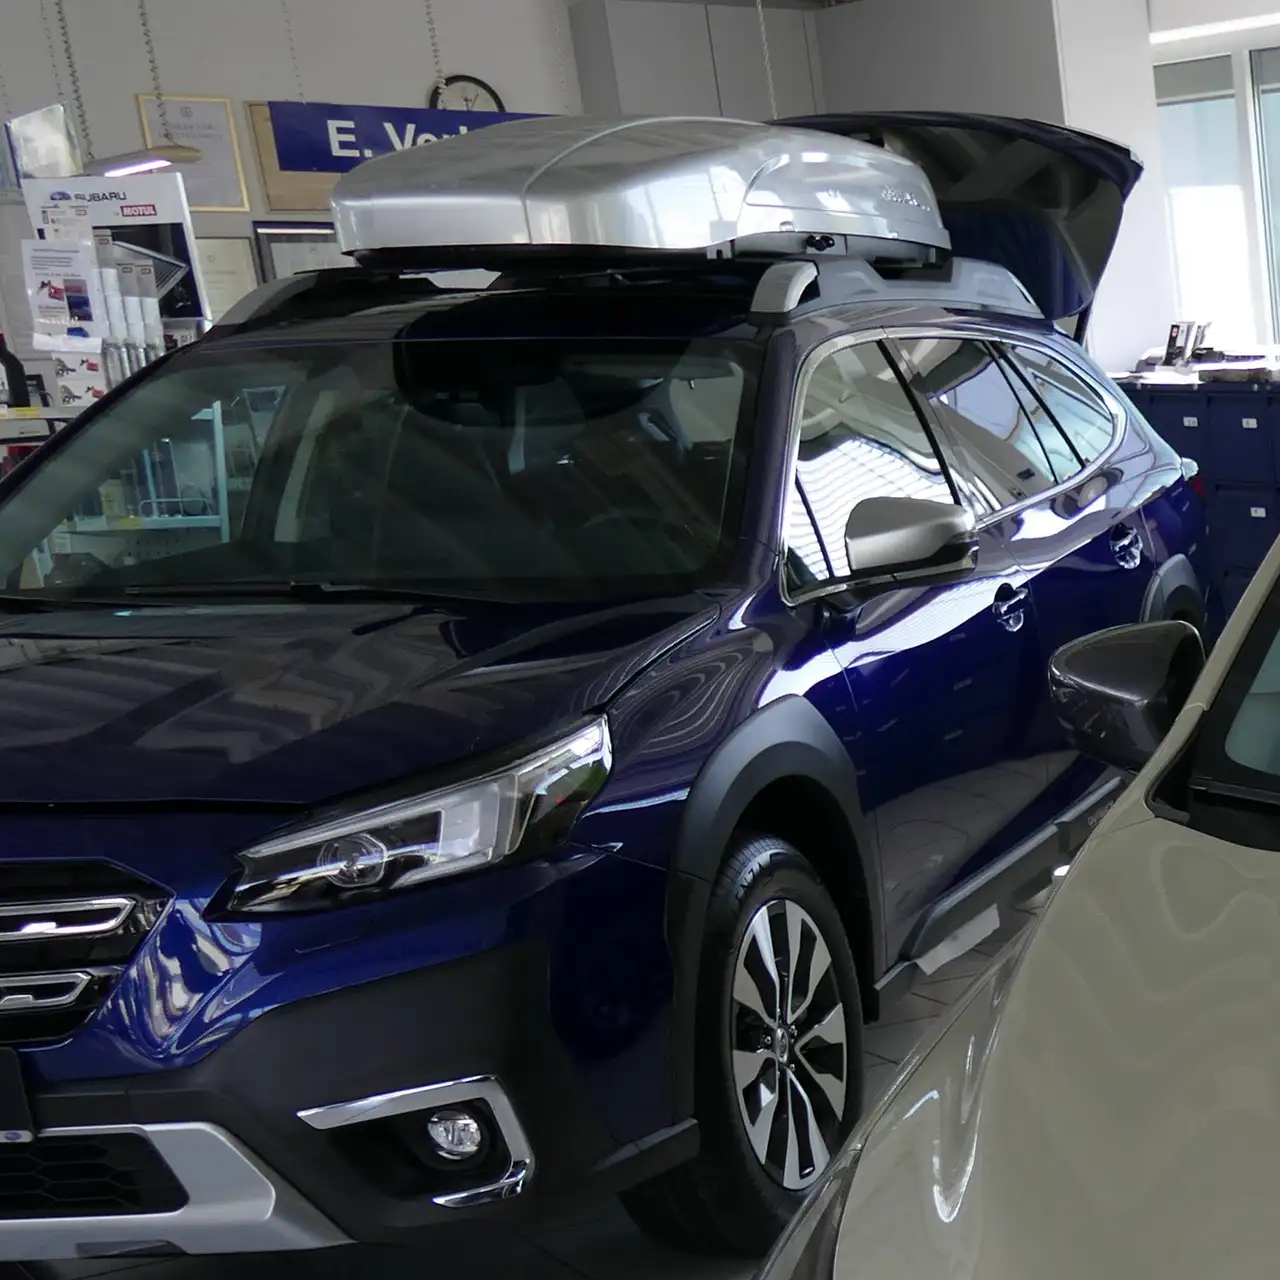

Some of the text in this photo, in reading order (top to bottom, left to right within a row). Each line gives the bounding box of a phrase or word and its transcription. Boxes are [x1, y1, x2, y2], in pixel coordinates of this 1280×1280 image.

[327, 119, 373, 158] E.
[74, 191, 127, 202] SUBARU
[122, 205, 156, 217] MOTUL
